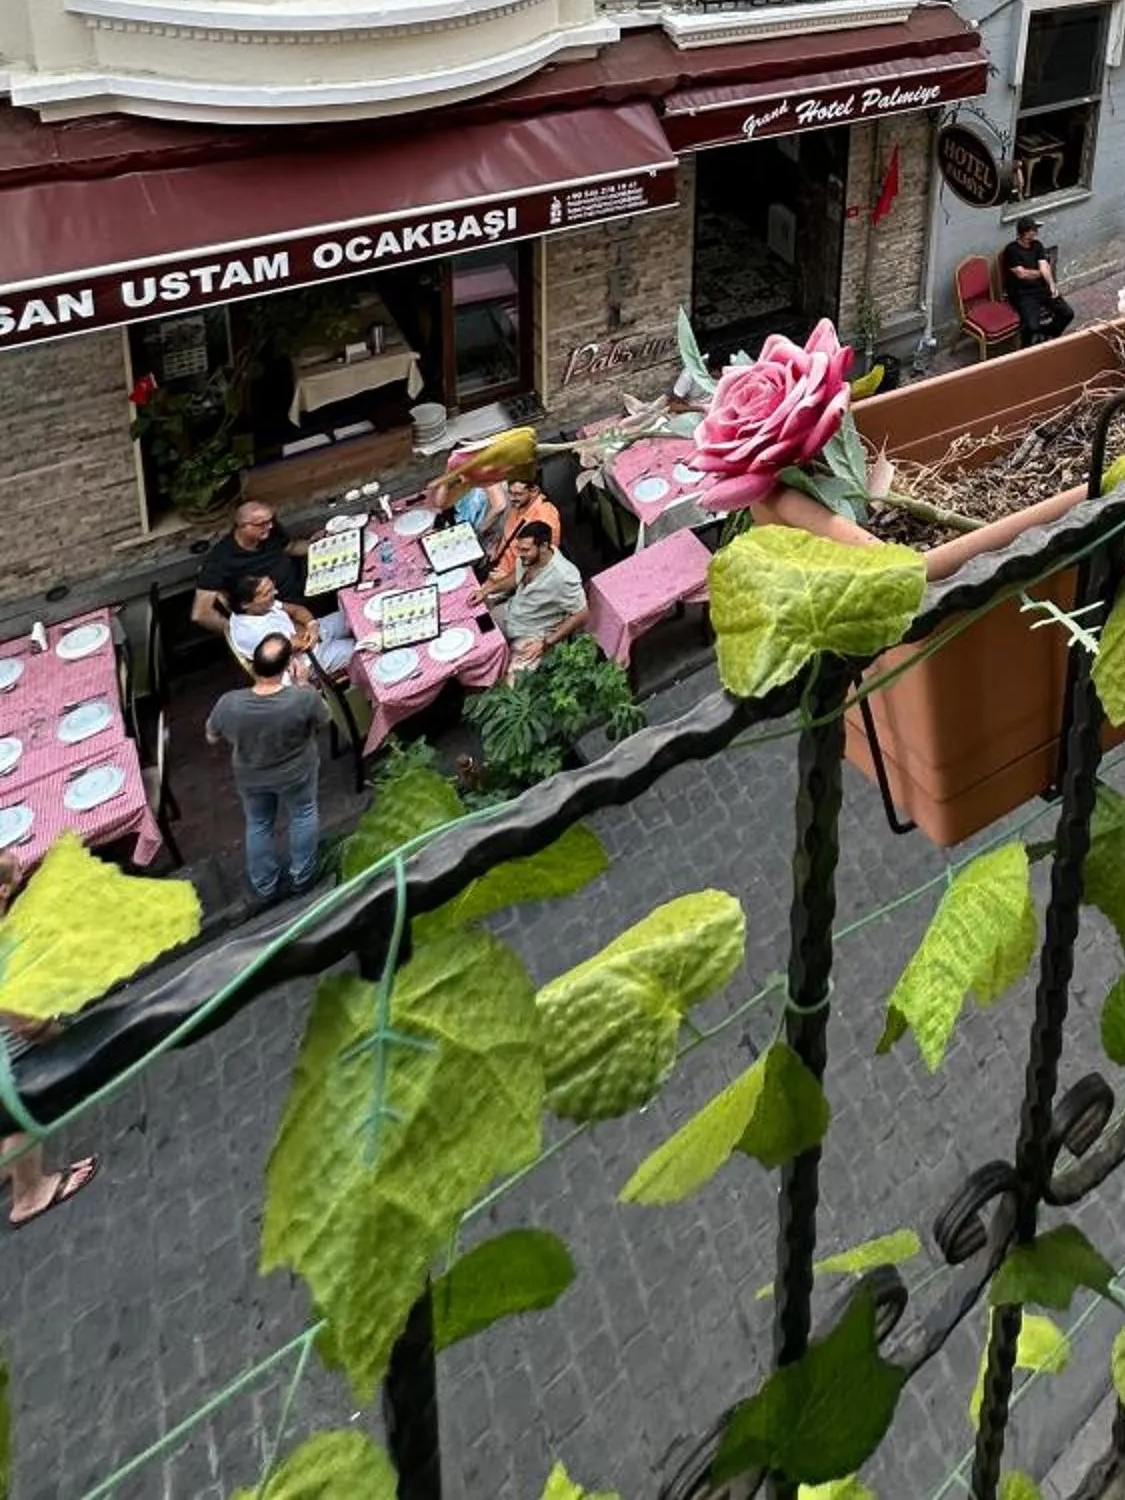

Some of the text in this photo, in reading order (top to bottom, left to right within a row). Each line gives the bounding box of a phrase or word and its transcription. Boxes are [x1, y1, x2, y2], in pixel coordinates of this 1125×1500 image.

[741, 85, 941, 138] Grand Hotel Palmiye
[945, 138, 993, 189] HOTEL
[121, 251, 290, 307] USTAM
[313, 207, 518, 269] OCAKBAŞI
